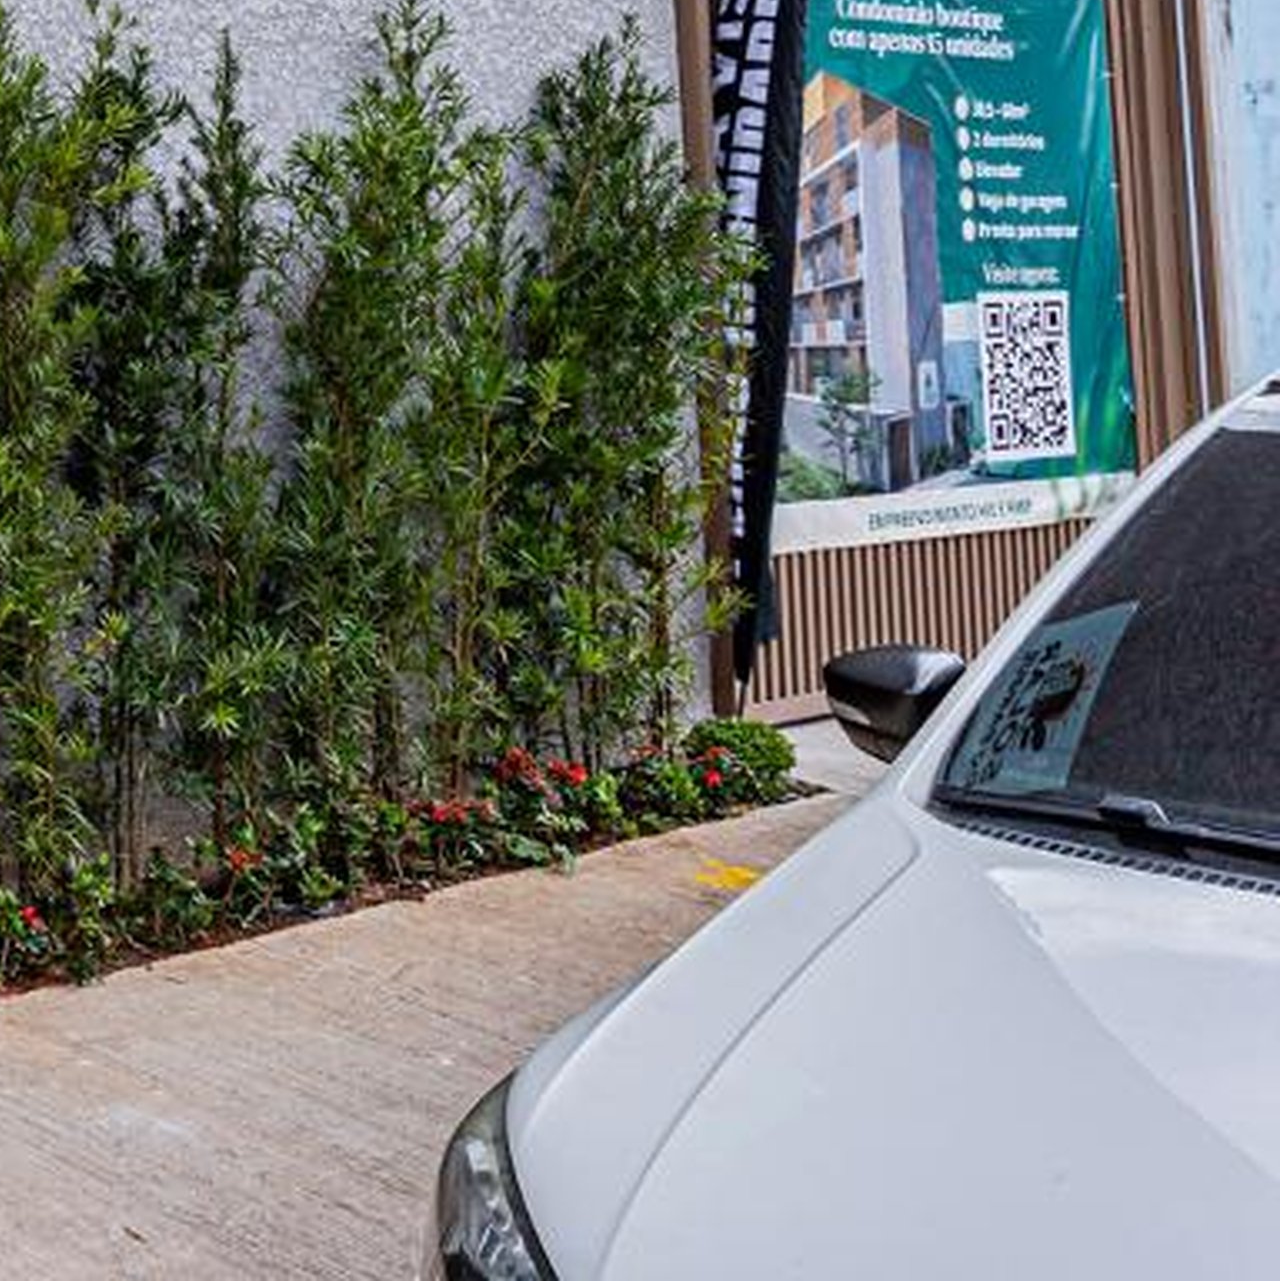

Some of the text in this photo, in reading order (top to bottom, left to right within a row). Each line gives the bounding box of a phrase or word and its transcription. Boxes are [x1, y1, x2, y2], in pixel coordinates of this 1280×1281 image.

[829, 27, 866, 49] com
[869, 30, 929, 59] apenas
[945, 33, 1015, 61] unidades
